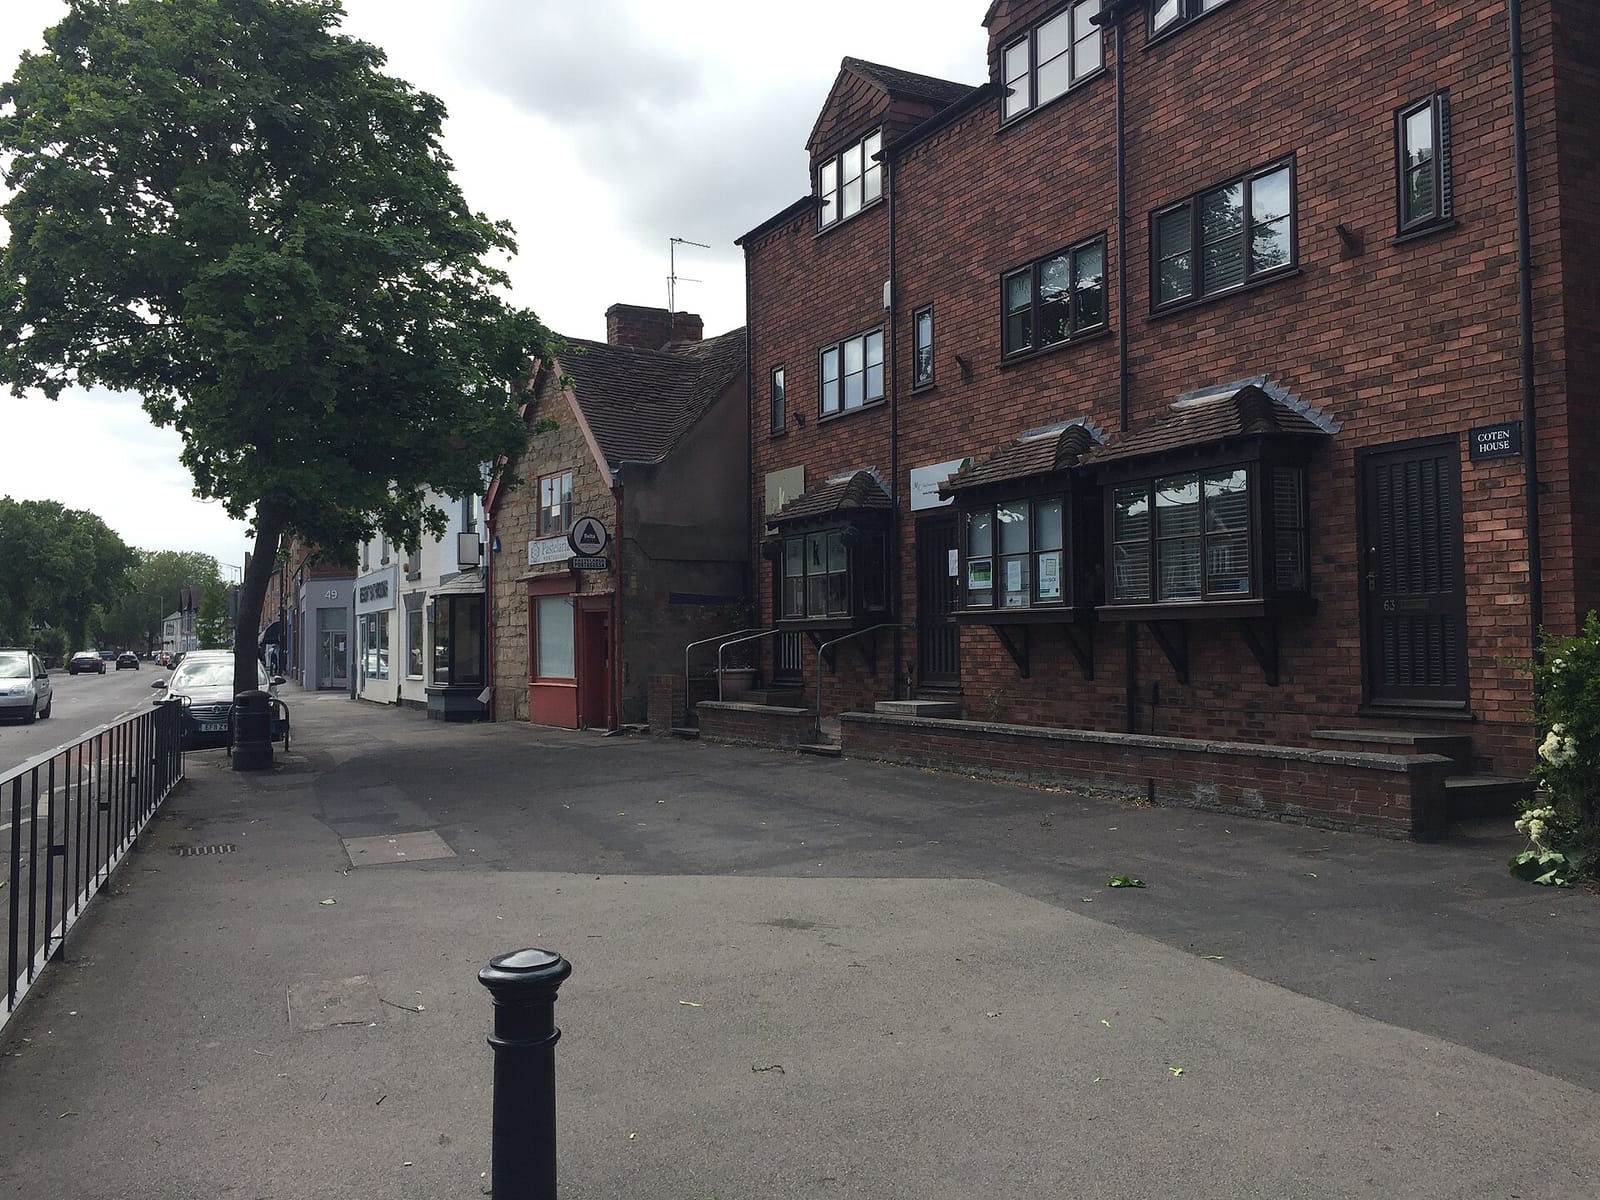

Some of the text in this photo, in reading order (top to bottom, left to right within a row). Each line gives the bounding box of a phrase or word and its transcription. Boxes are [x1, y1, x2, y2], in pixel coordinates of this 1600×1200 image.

[1477, 429, 1510, 442] COTEN
[1479, 440, 1510, 452] HOUSE
[325, 590, 338, 599] 49
[1383, 599, 1396, 611] 63
